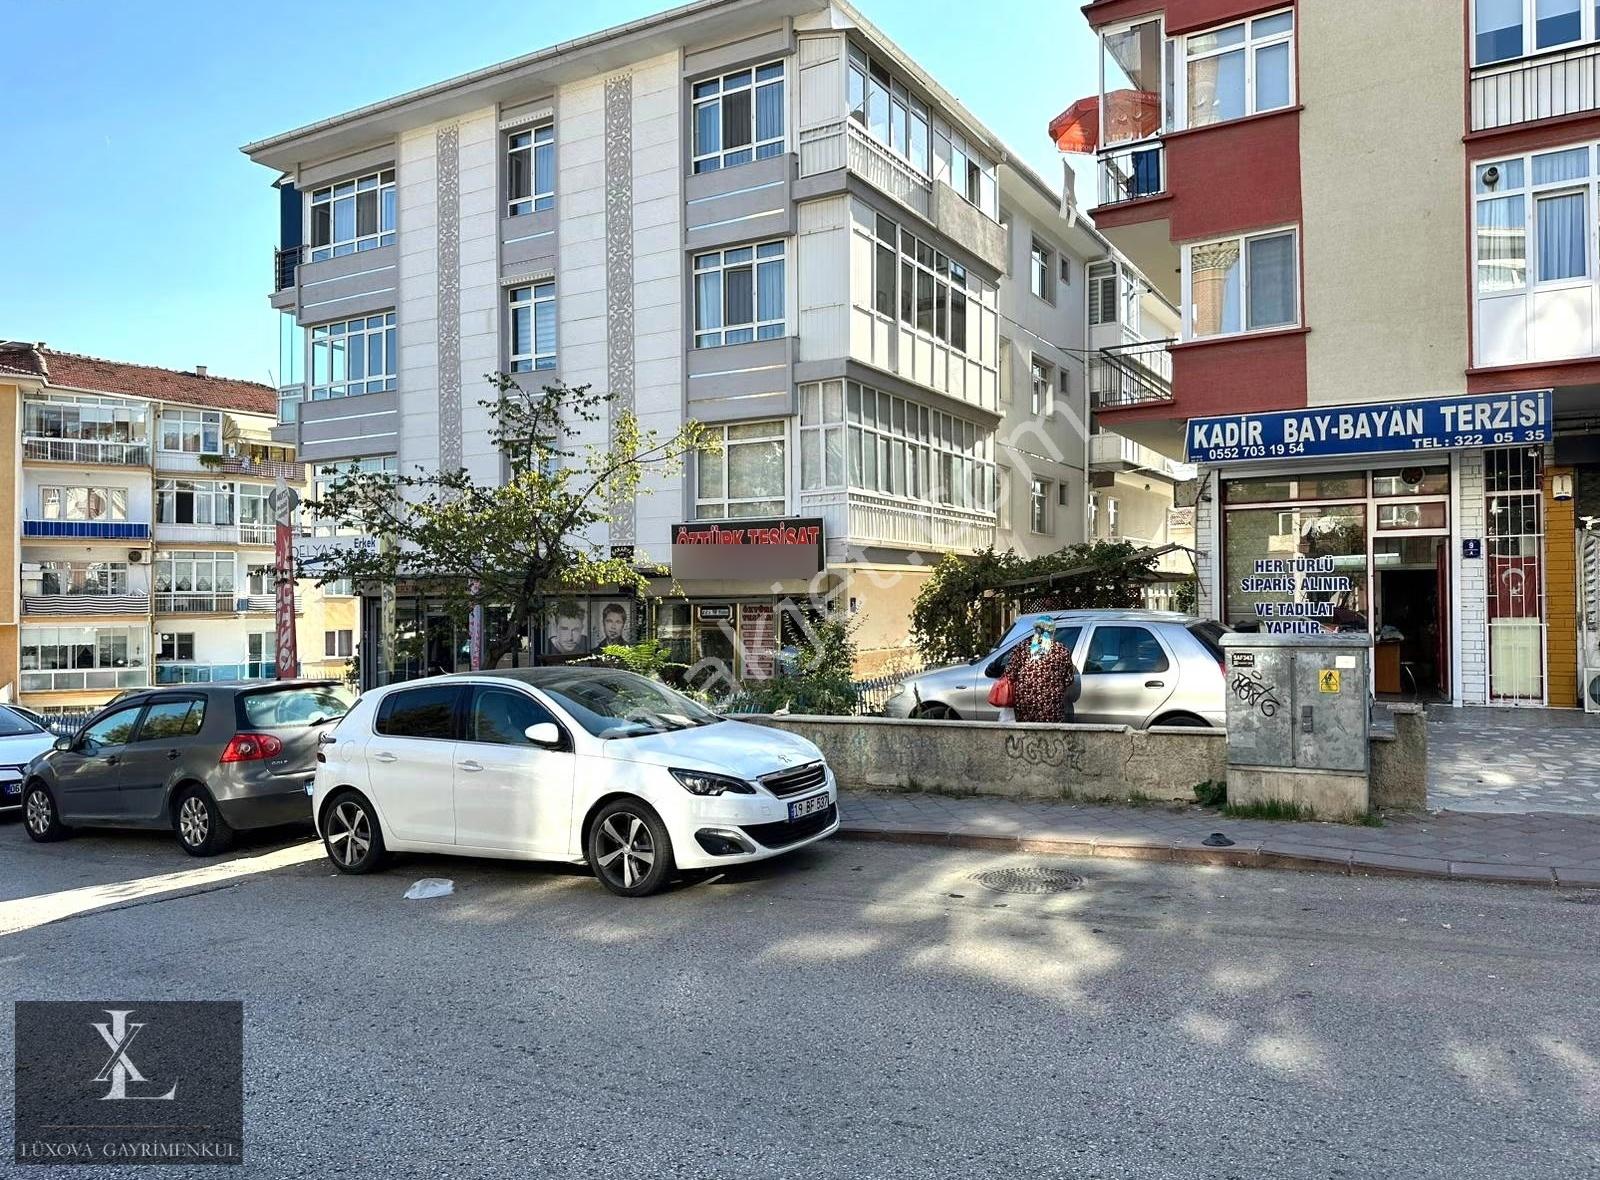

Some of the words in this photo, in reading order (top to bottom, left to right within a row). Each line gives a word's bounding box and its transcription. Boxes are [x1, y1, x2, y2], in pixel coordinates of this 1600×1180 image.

[1193, 416, 1263, 449] KADİR
[1284, 408, 1424, 443] BAY-BAYAN
[1440, 392, 1545, 432] TERZİSİ
[1454, 434, 1484, 446] 322
[1494, 432, 1514, 443] 05
[1525, 429, 1545, 441] 35
[1209, 447, 1239, 460] 0552
[1242, 446, 1266, 457] 703
[1270, 444, 1285, 455] 19
[1288, 442, 1305, 454] 54
[676, 525, 745, 545] ÖZTÜRK
[1254, 559, 1283, 573] HER
[1287, 556, 1335, 573] TÜRLÜ
[1241, 575, 1296, 595] SİPARİŞ
[1300, 576, 1351, 592] ALINIR
[1254, 602, 1273, 616] VE
[1277, 600, 1335, 616] TADİLAT
[794, 803, 803, 817] 19
[806, 799, 815, 813] BF
